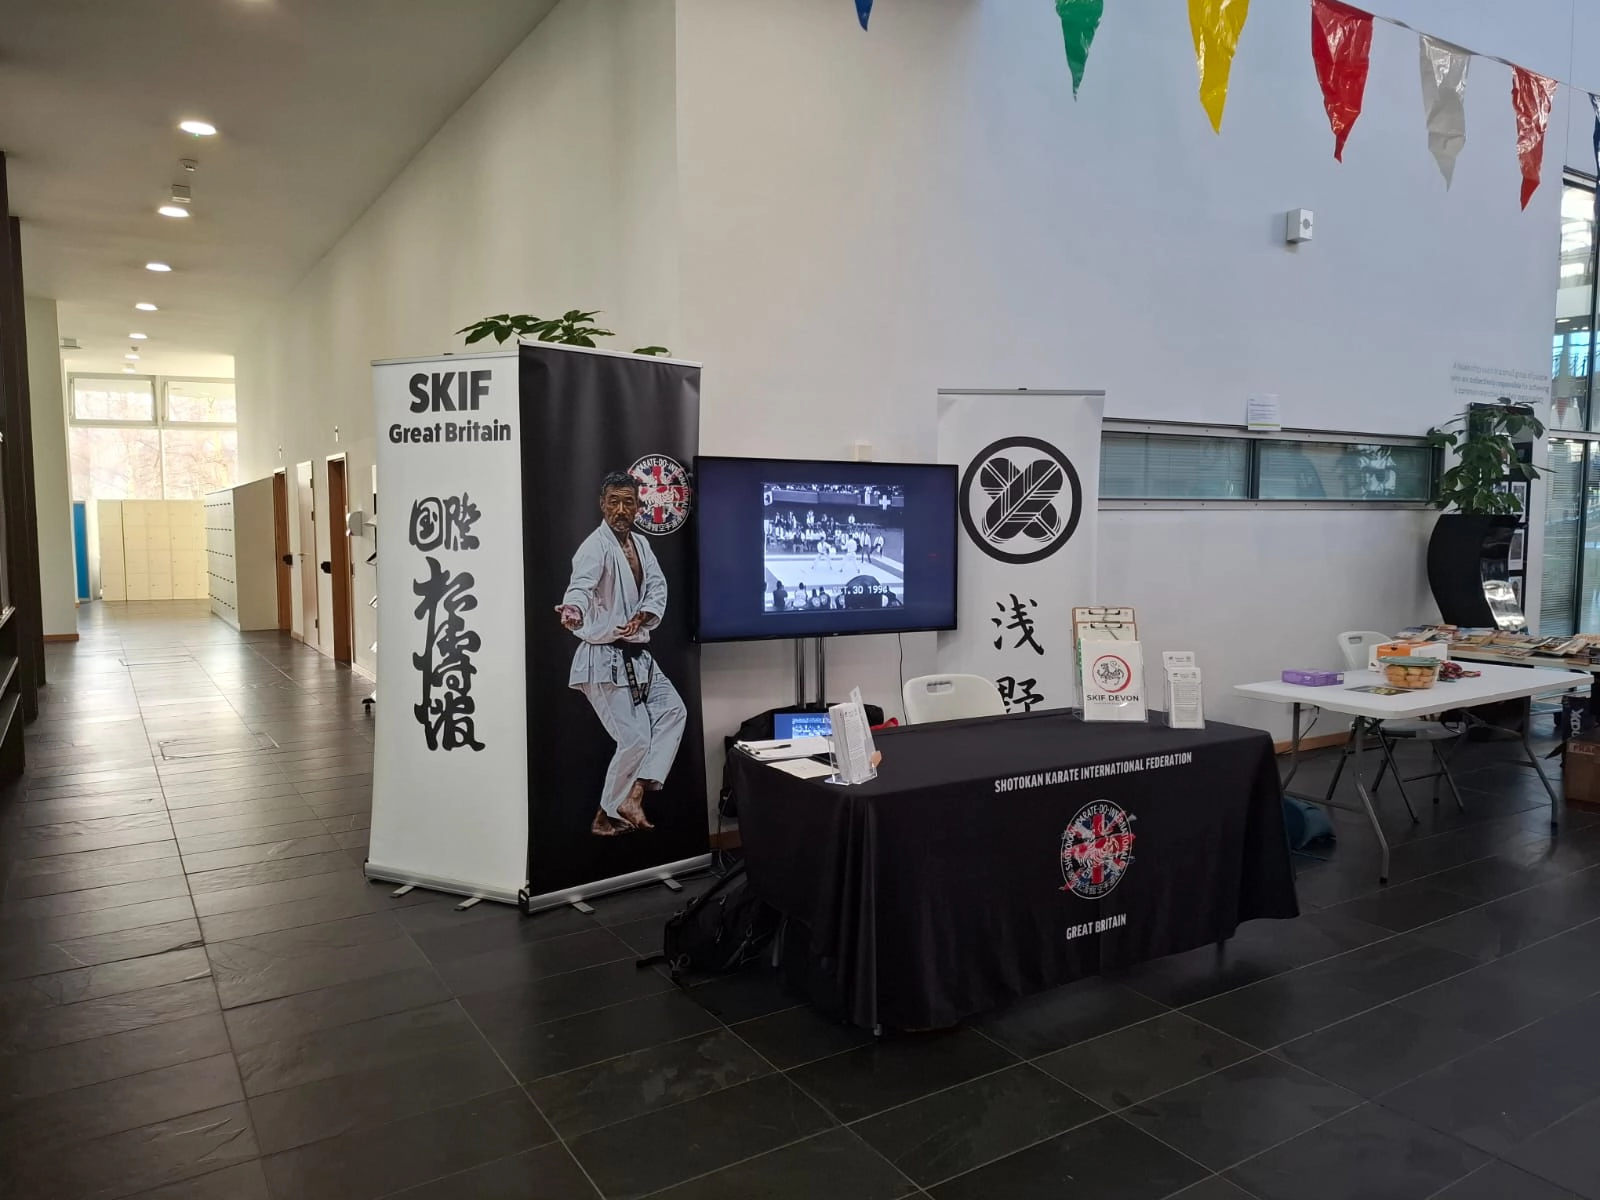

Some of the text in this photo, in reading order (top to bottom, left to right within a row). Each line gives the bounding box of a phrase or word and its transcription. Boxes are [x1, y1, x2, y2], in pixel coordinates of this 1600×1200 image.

[409, 370, 492, 413] SKIF
[389, 419, 511, 444] Great Britain
[852, 585, 864, 595] 30
[1087, 694, 1139, 702] SKIF DEVON
[995, 752, 1192, 793] SHOTOKAN KARATE INTERNATIONAL FEDERATION
[1066, 913, 1127, 940] GREAT BRITAIN
